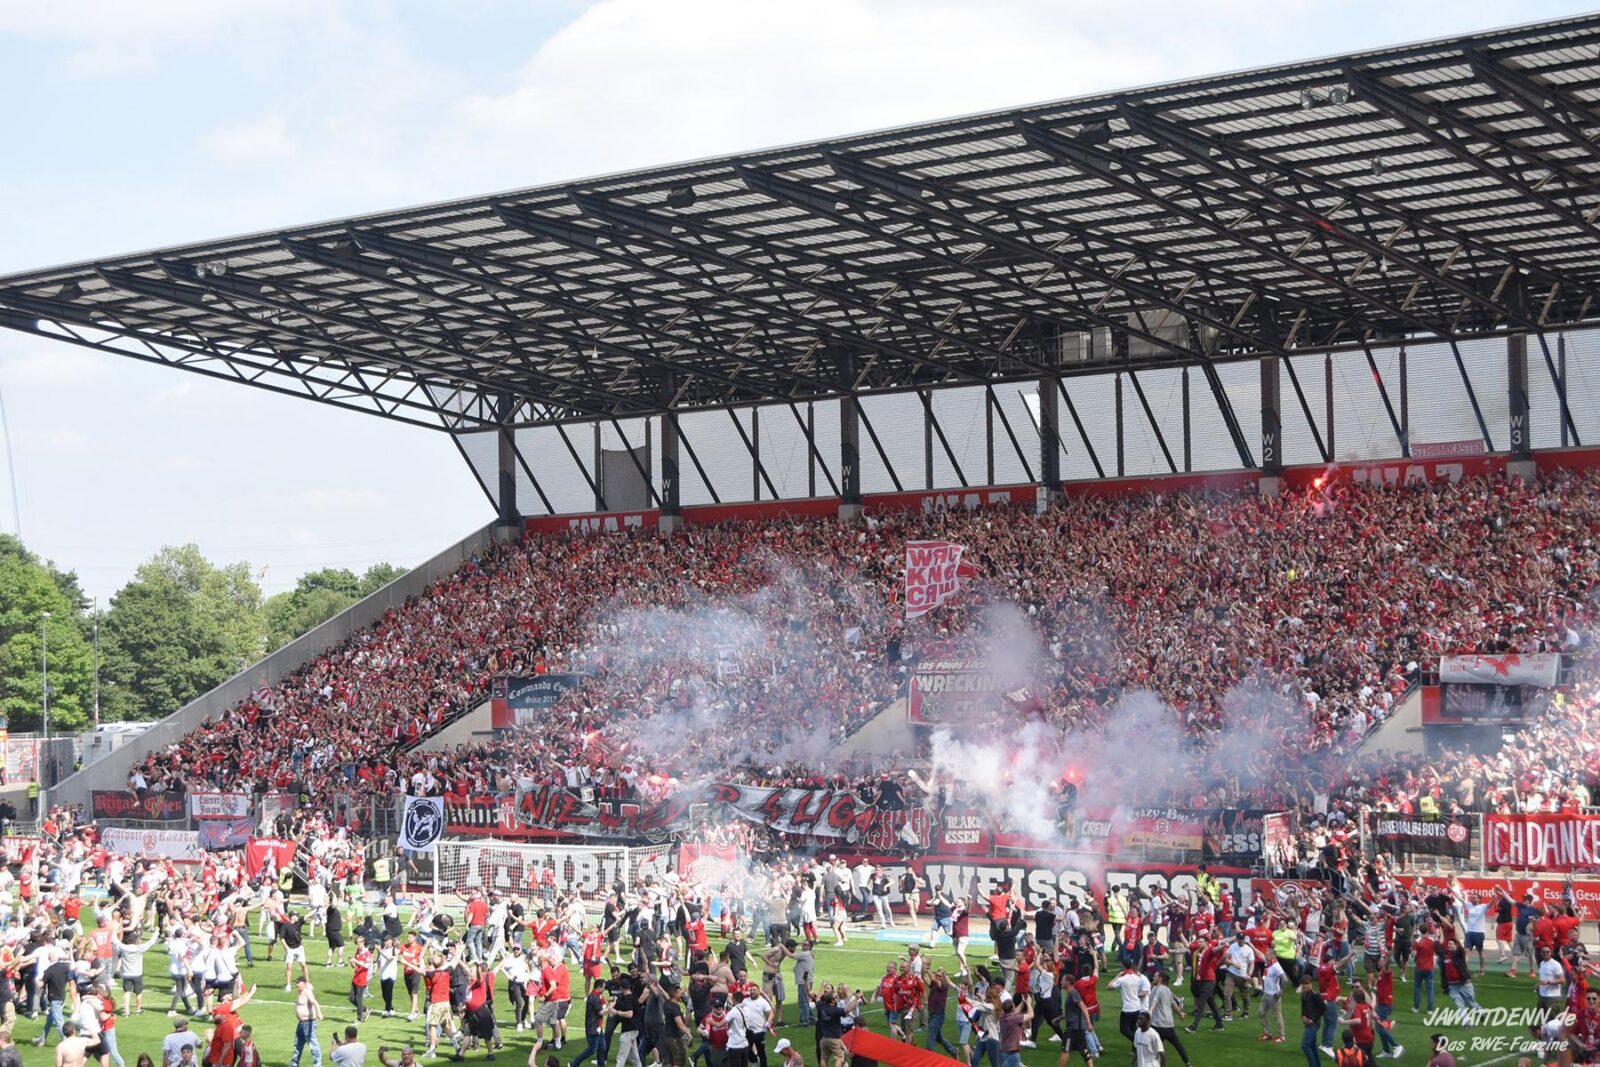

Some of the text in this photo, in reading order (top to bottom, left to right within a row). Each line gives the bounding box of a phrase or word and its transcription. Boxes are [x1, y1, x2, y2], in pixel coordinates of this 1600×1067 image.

[1510, 415, 1523, 428] W
[1263, 433, 1274, 446] W
[1512, 429, 1522, 445] 3
[1264, 447, 1273, 462] 2
[1422, 822, 1446, 837] BOYS
[1487, 820, 1524, 865] ICH
